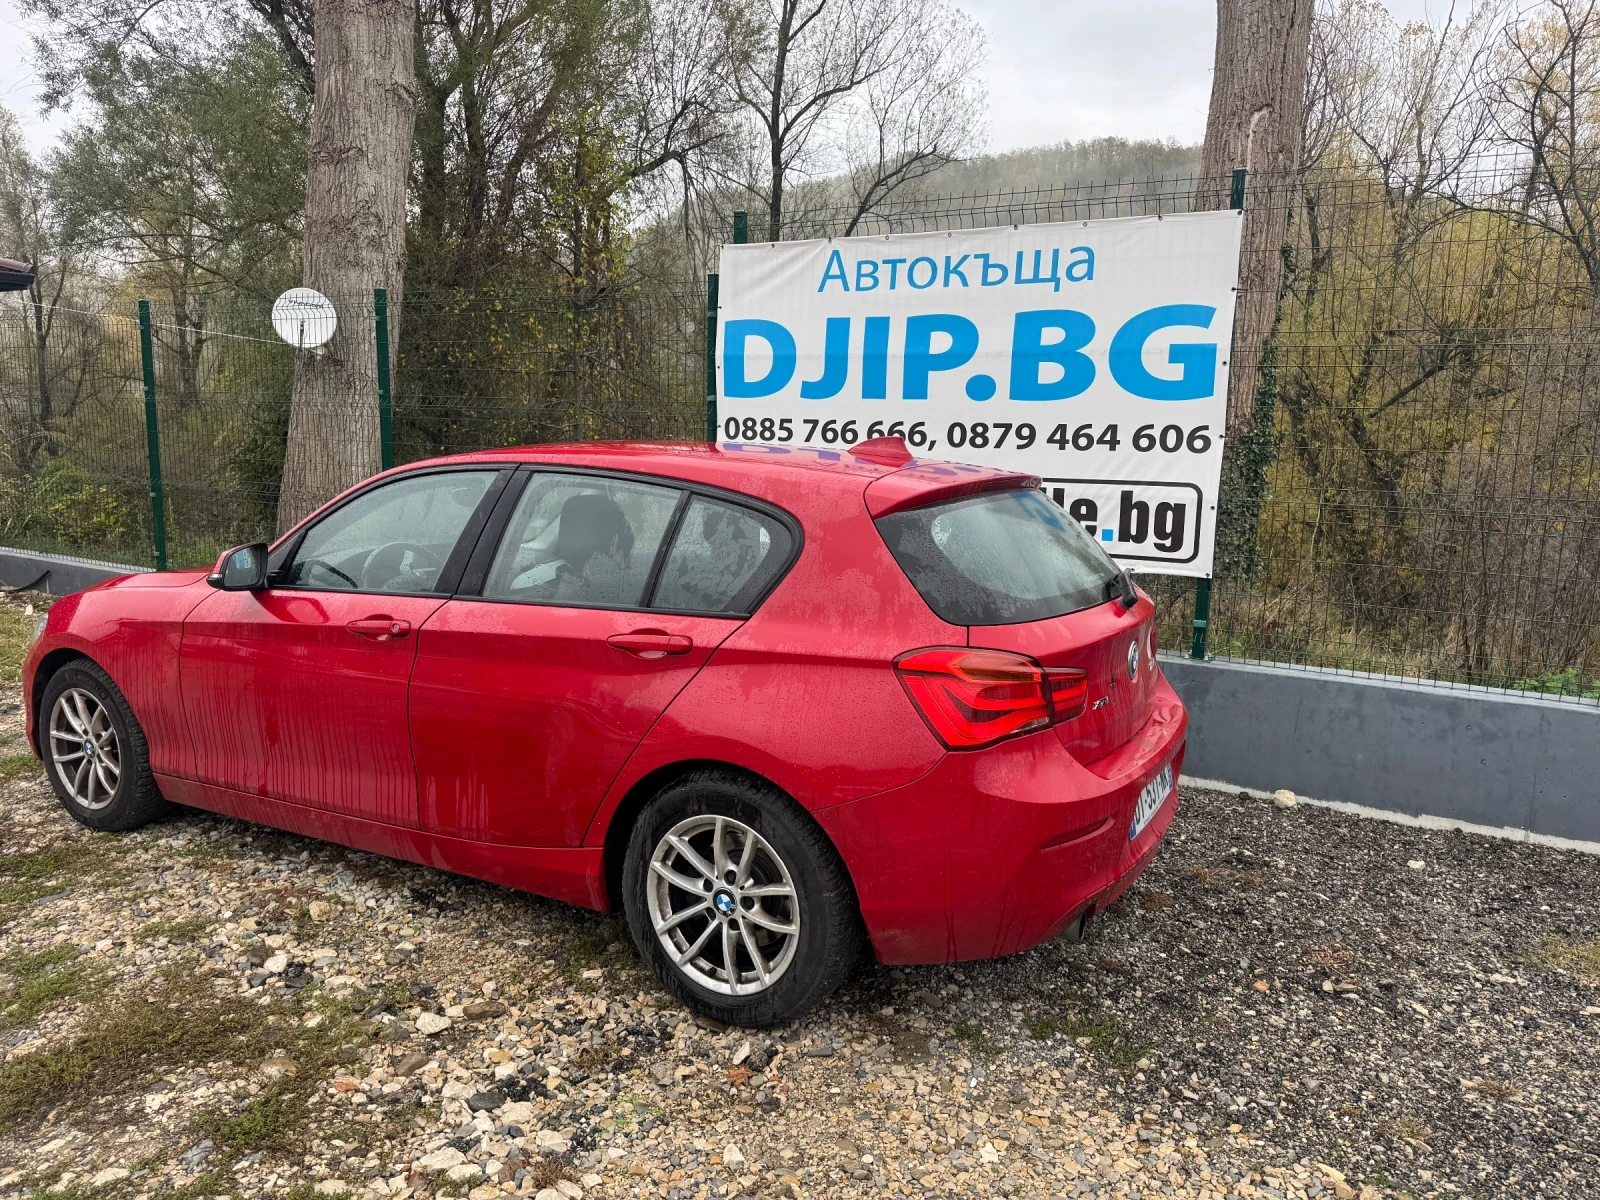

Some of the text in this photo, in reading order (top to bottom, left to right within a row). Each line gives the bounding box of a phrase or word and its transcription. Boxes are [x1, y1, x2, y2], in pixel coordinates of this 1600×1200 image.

[817, 245, 1096, 293] Автокъща
[722, 303, 1218, 403] DJIP.BG
[724, 416, 794, 442] 0885
[802, 418, 859, 445] 766
[946, 421, 1037, 450] 0879
[1046, 423, 1121, 452] 464
[1132, 423, 1212, 454] 606
